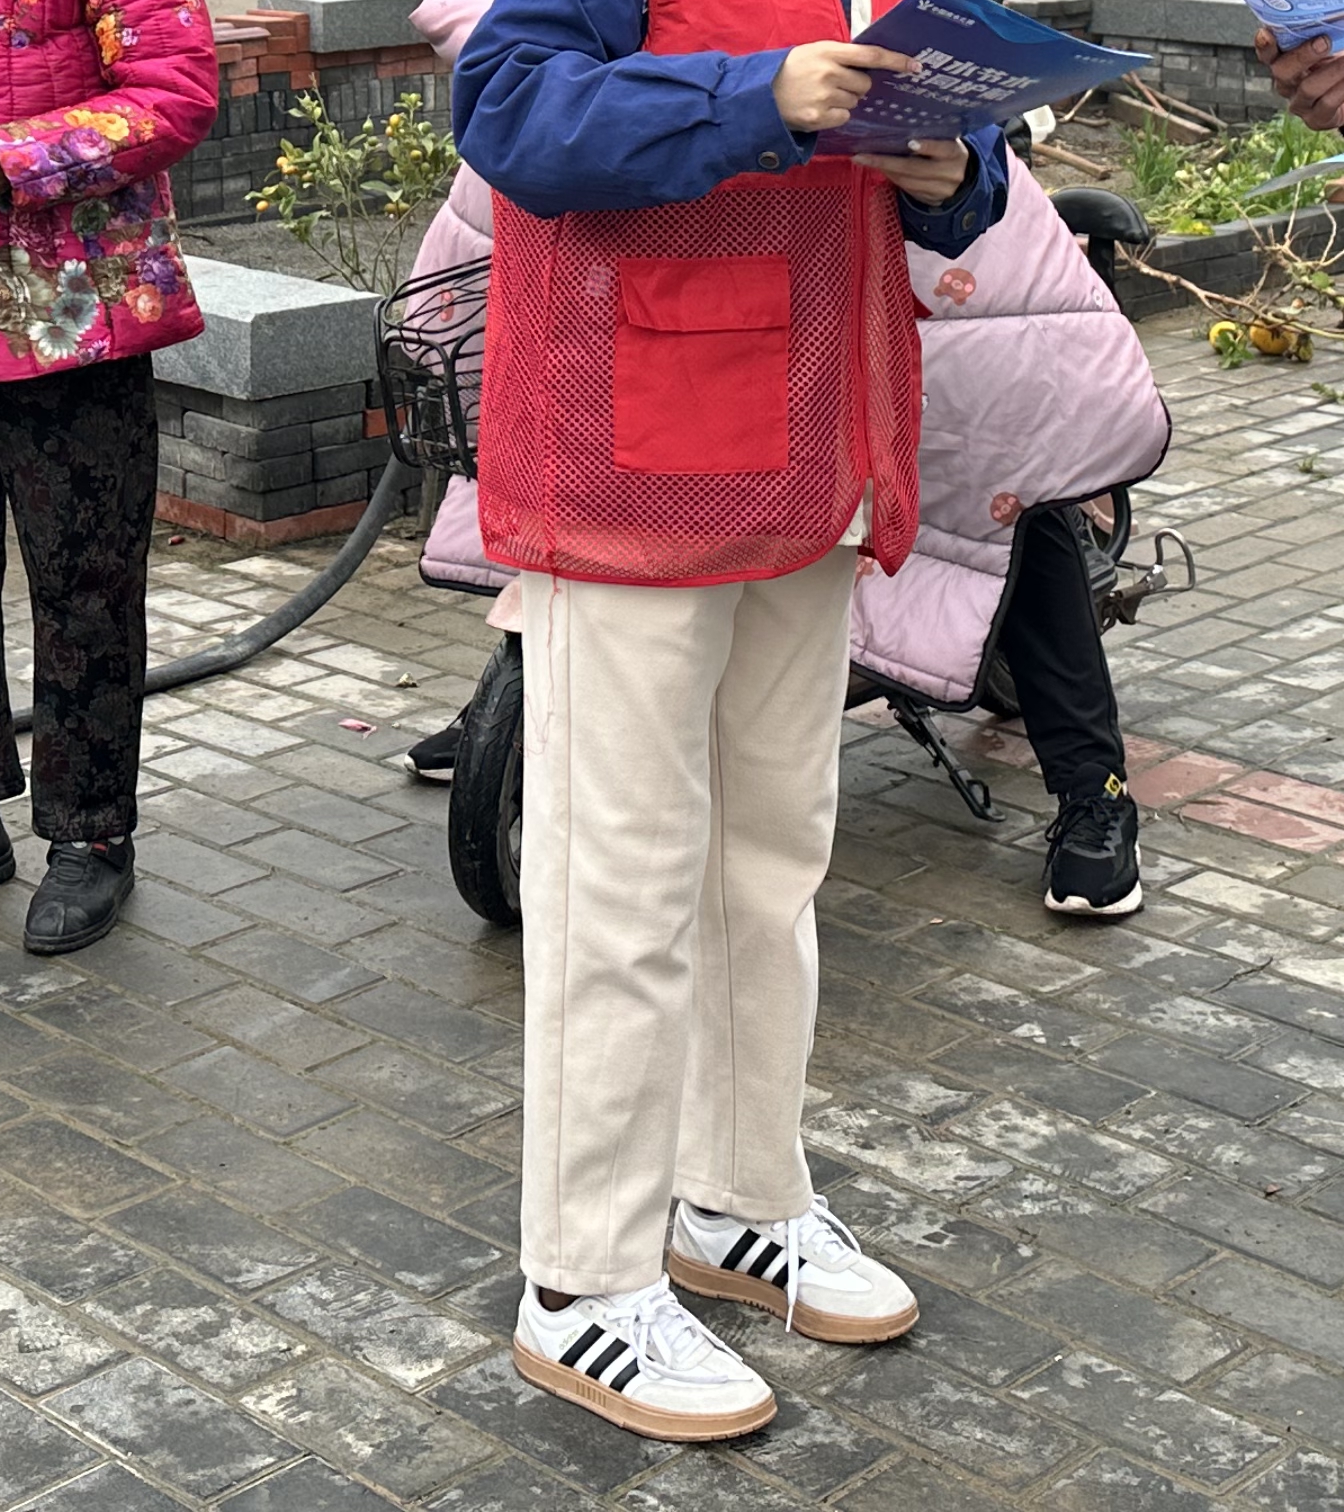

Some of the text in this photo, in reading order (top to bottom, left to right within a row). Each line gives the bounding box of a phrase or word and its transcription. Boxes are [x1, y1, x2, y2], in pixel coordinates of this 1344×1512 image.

[893, 68, 1016, 101] 共同护航
[913, 47, 1040, 89] 调水节水
